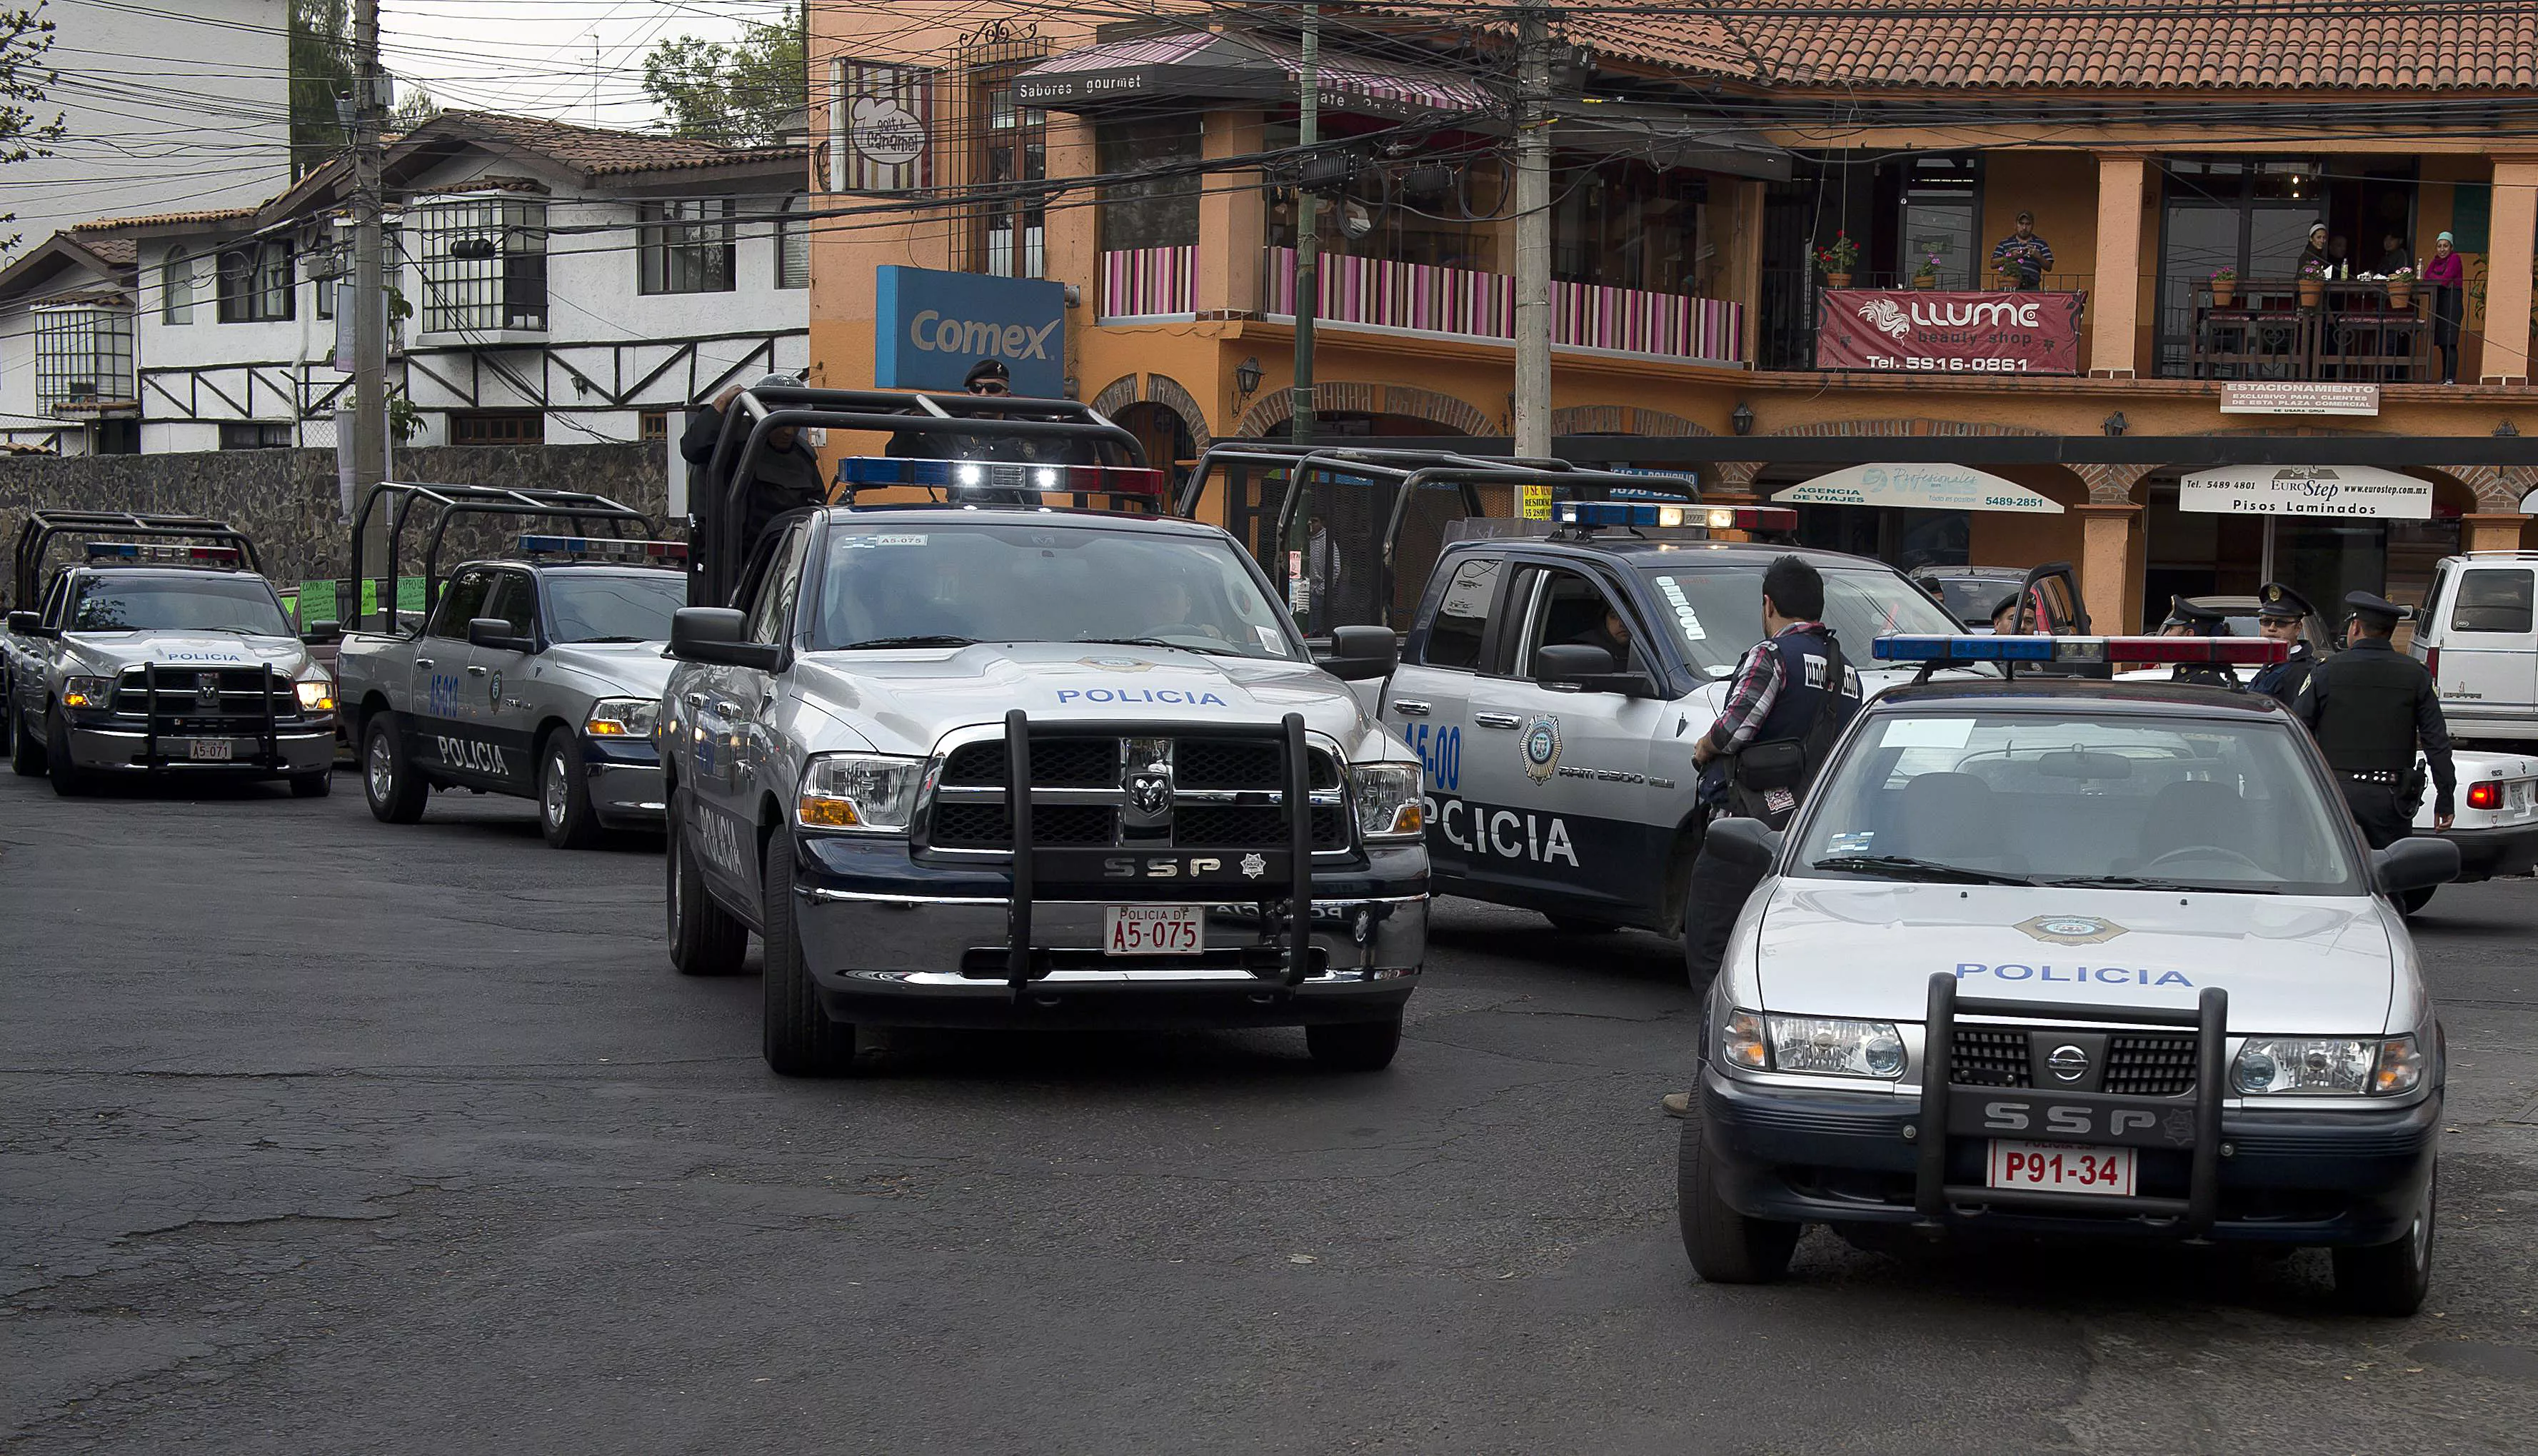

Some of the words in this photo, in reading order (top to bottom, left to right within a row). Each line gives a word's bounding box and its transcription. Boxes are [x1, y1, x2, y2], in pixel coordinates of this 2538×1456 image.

[1020, 84, 1072, 98] Sabores
[1086, 74, 1141, 94] gourmet
[911, 309, 1061, 359] Comex
[1918, 331, 1977, 346] beauty
[1988, 331, 2032, 345] shop
[1866, 356, 1900, 368] Tel.
[1905, 357, 2028, 371] 5916-0861
[2227, 383, 2374, 393] ESTACIONAMIENTO
[1797, 487, 1860, 496] AGENCIA
[2187, 480, 2201, 488] Tel.
[2234, 481, 2256, 490] 4801
[1985, 496, 2044, 508] 5489-2851
[2233, 500, 2276, 512] Pisos
[2286, 502, 2377, 515] Laminados
[169, 653, 241, 662] POLICIA
[430, 673, 458, 718] A5-013
[1057, 689, 1228, 707] POLICIA
[193, 745, 228, 758] A5-071
[437, 735, 509, 775] POLICIA
[1425, 796, 1580, 867] POICIA
[699, 805, 744, 878] POLICIA
[1103, 857, 1221, 878] SSP
[1120, 910, 1168, 920] POLICIA
[1173, 910, 1189, 920] DF
[1113, 920, 1198, 950] A5-075
[1956, 963, 2195, 988] POLICIA
[1985, 1102, 2156, 1136] SSP
[2005, 1151, 2119, 1186] P91-34
